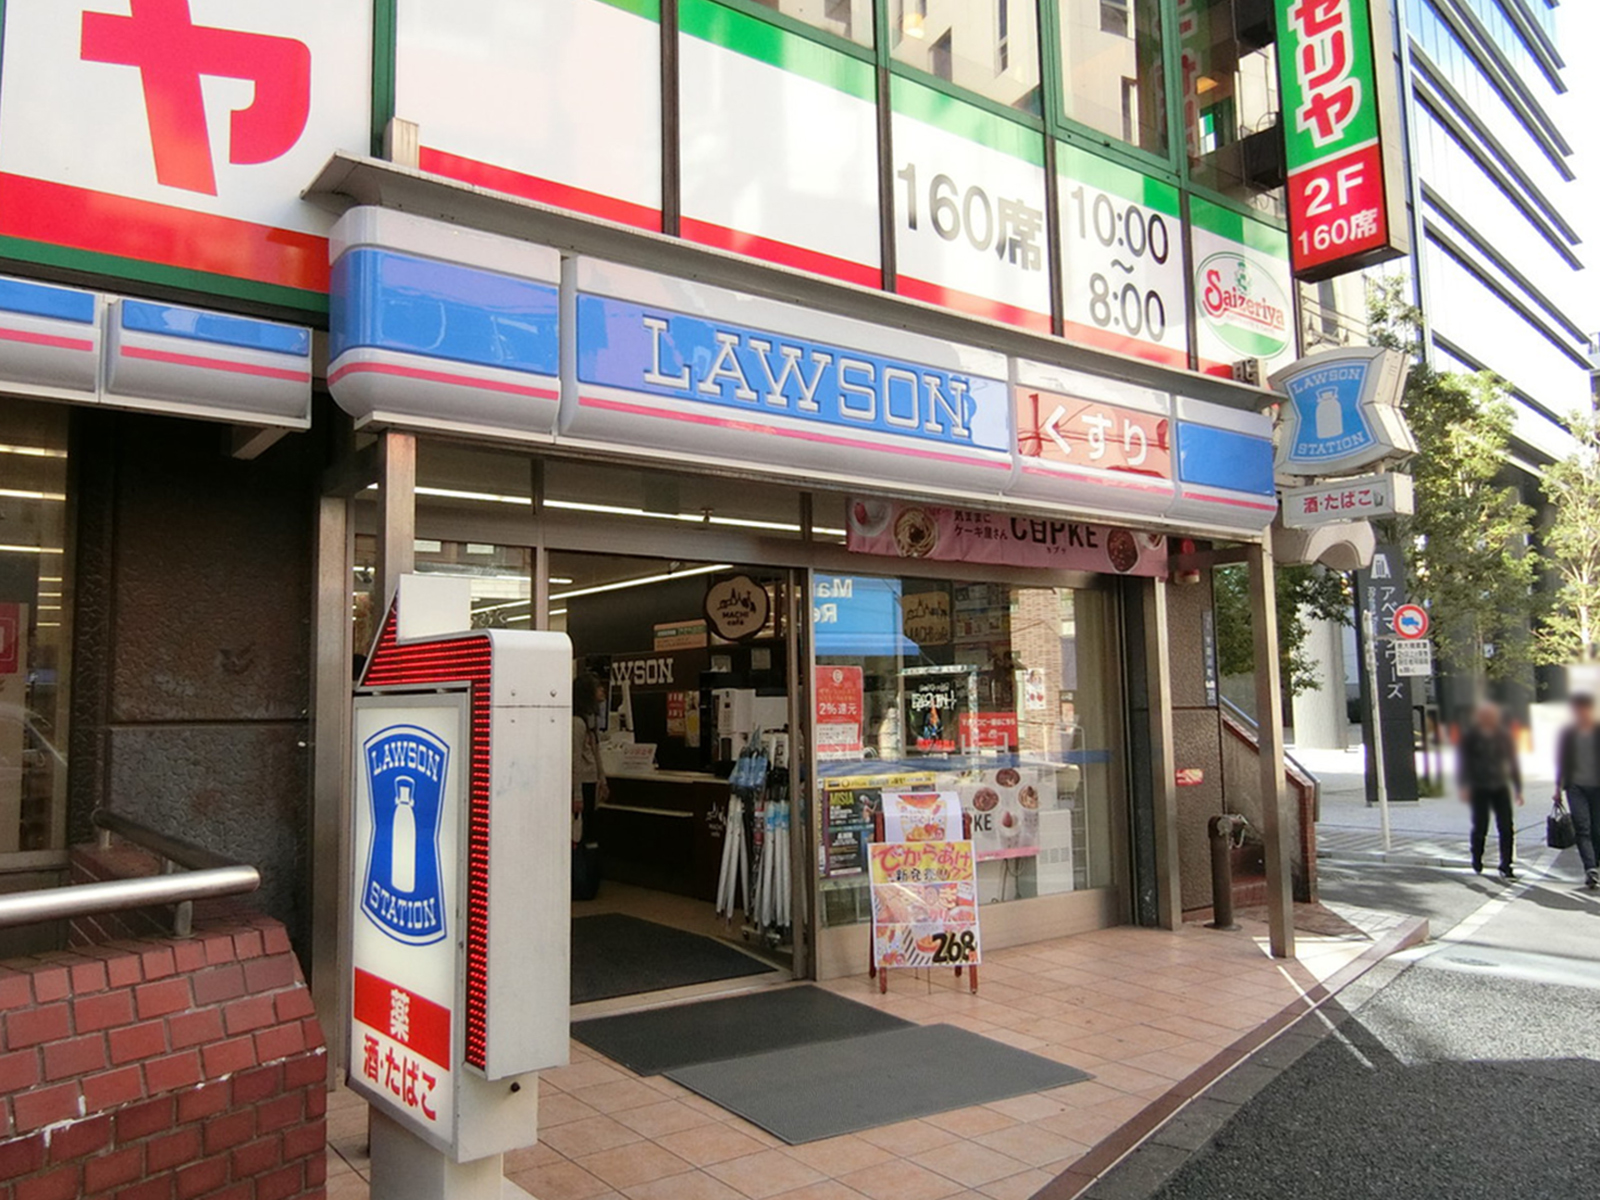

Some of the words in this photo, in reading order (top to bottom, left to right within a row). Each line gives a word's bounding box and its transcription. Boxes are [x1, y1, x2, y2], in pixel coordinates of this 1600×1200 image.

[79, 0, 311, 196] ヤ
[897, 162, 1043, 272] 160席
[1303, 162, 1364, 217] 2F
[1070, 185, 1169, 265] 10:00
[1298, 207, 1378, 255] 160席
[1089, 272, 1165, 342] 8:00
[1204, 269, 1285, 328] Saizeriya
[642, 315, 971, 439] LAWSON
[1292, 368, 1362, 395] LAWSON
[1045, 405, 1147, 466] くすり
[1297, 431, 1366, 456] STATION
[1380, 586, 1404, 699] アベマワーズ
[371, 741, 440, 782] LAWSON
[369, 881, 436, 929] STATION
[932, 930, 976, 963] 268
[390, 988, 410, 1043] 薬
[364, 1033, 437, 1121] 酒・たばこ
